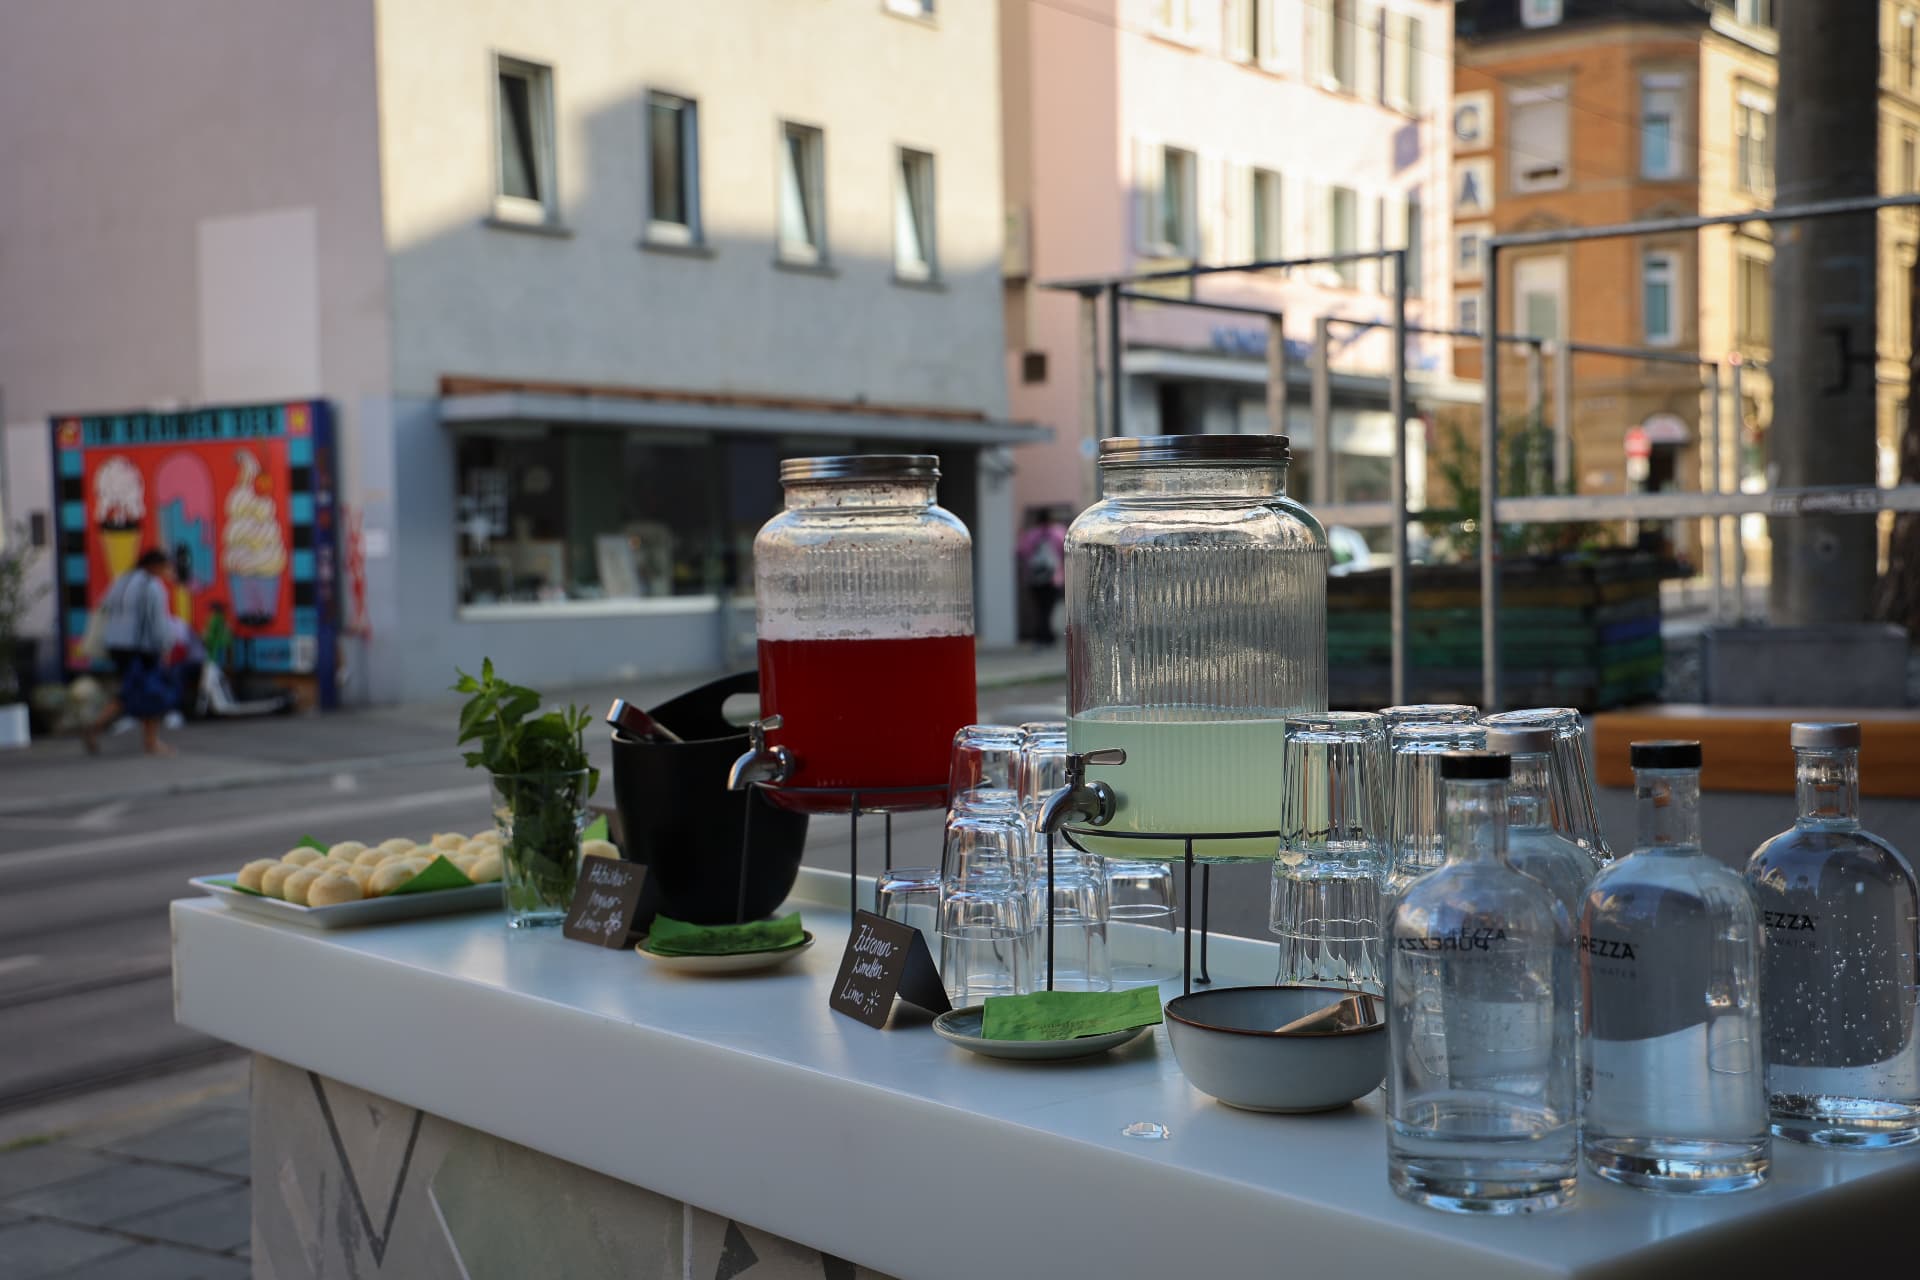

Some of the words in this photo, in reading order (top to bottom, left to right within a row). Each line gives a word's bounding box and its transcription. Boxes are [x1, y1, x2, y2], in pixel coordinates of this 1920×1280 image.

[1764, 910, 1815, 932] EZZA
[1578, 935, 1635, 960] REZZA
[840, 977, 864, 1005] Limo
